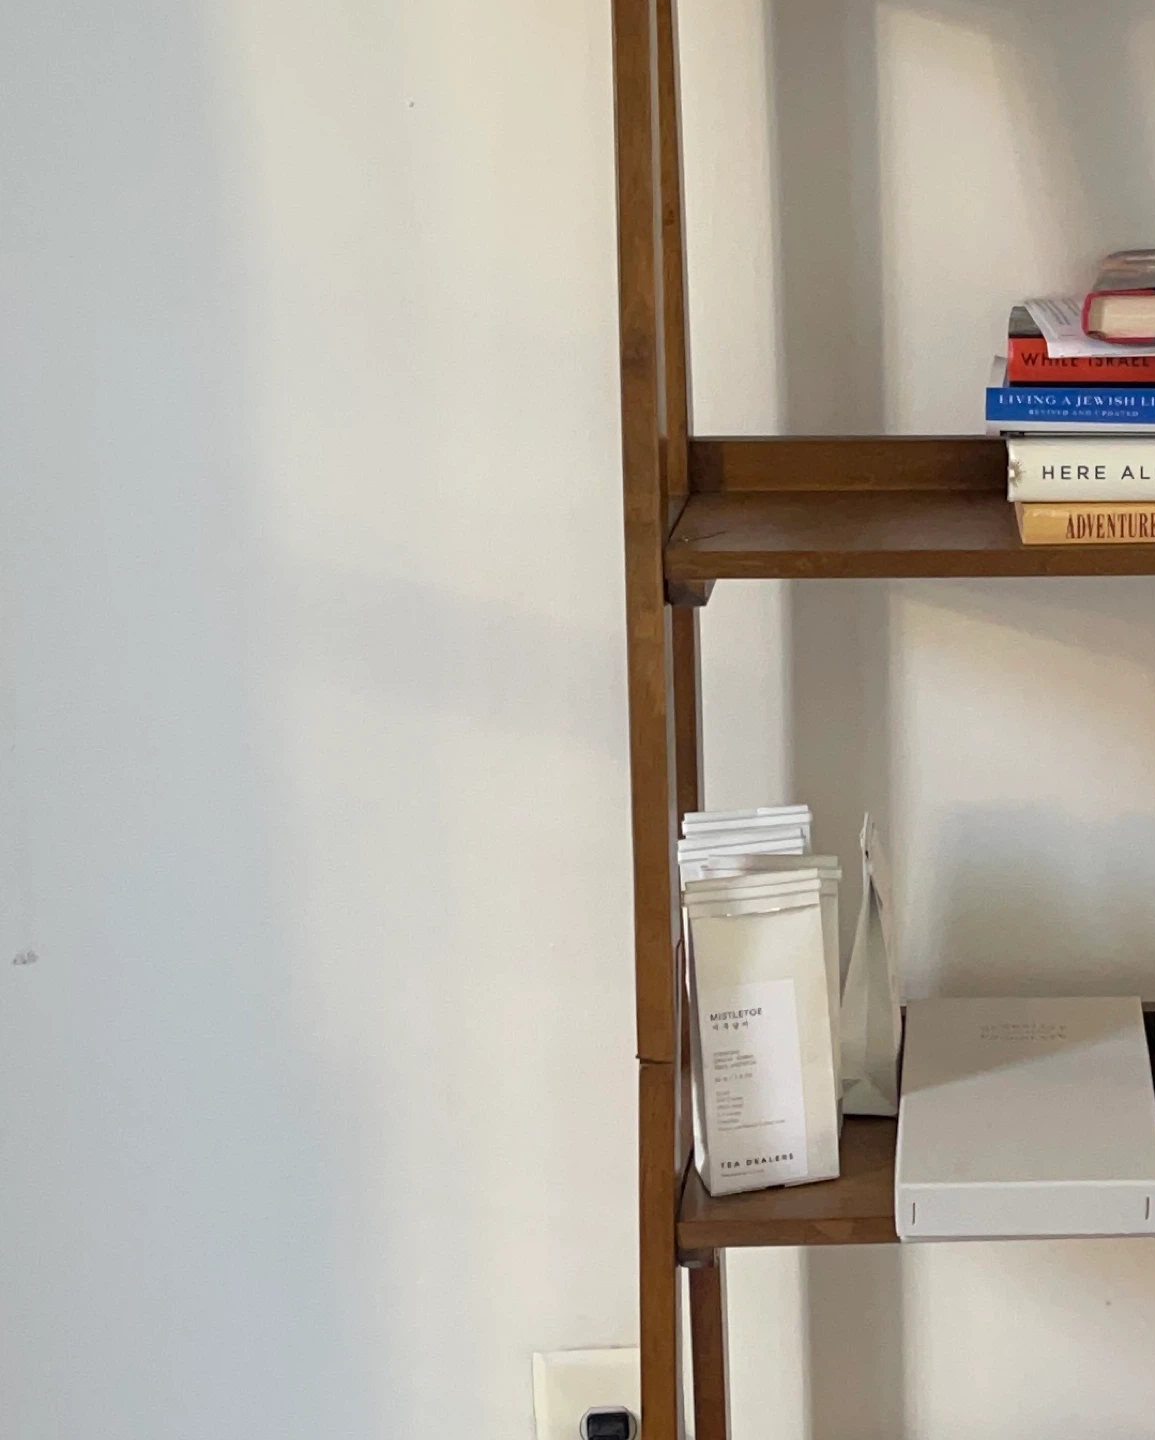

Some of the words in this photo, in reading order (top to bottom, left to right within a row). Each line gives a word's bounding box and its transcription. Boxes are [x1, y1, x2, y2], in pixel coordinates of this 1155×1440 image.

[998, 394, 1057, 406] LIVING
[1061, 395, 1073, 407] A
[1075, 394, 1136, 408] JEWISH
[1042, 465, 1107, 480] HERE
[709, 1007, 762, 1022] MISTLETOE
[720, 1161, 741, 1169] TEA
[746, 1152, 794, 1166] DEALERS
